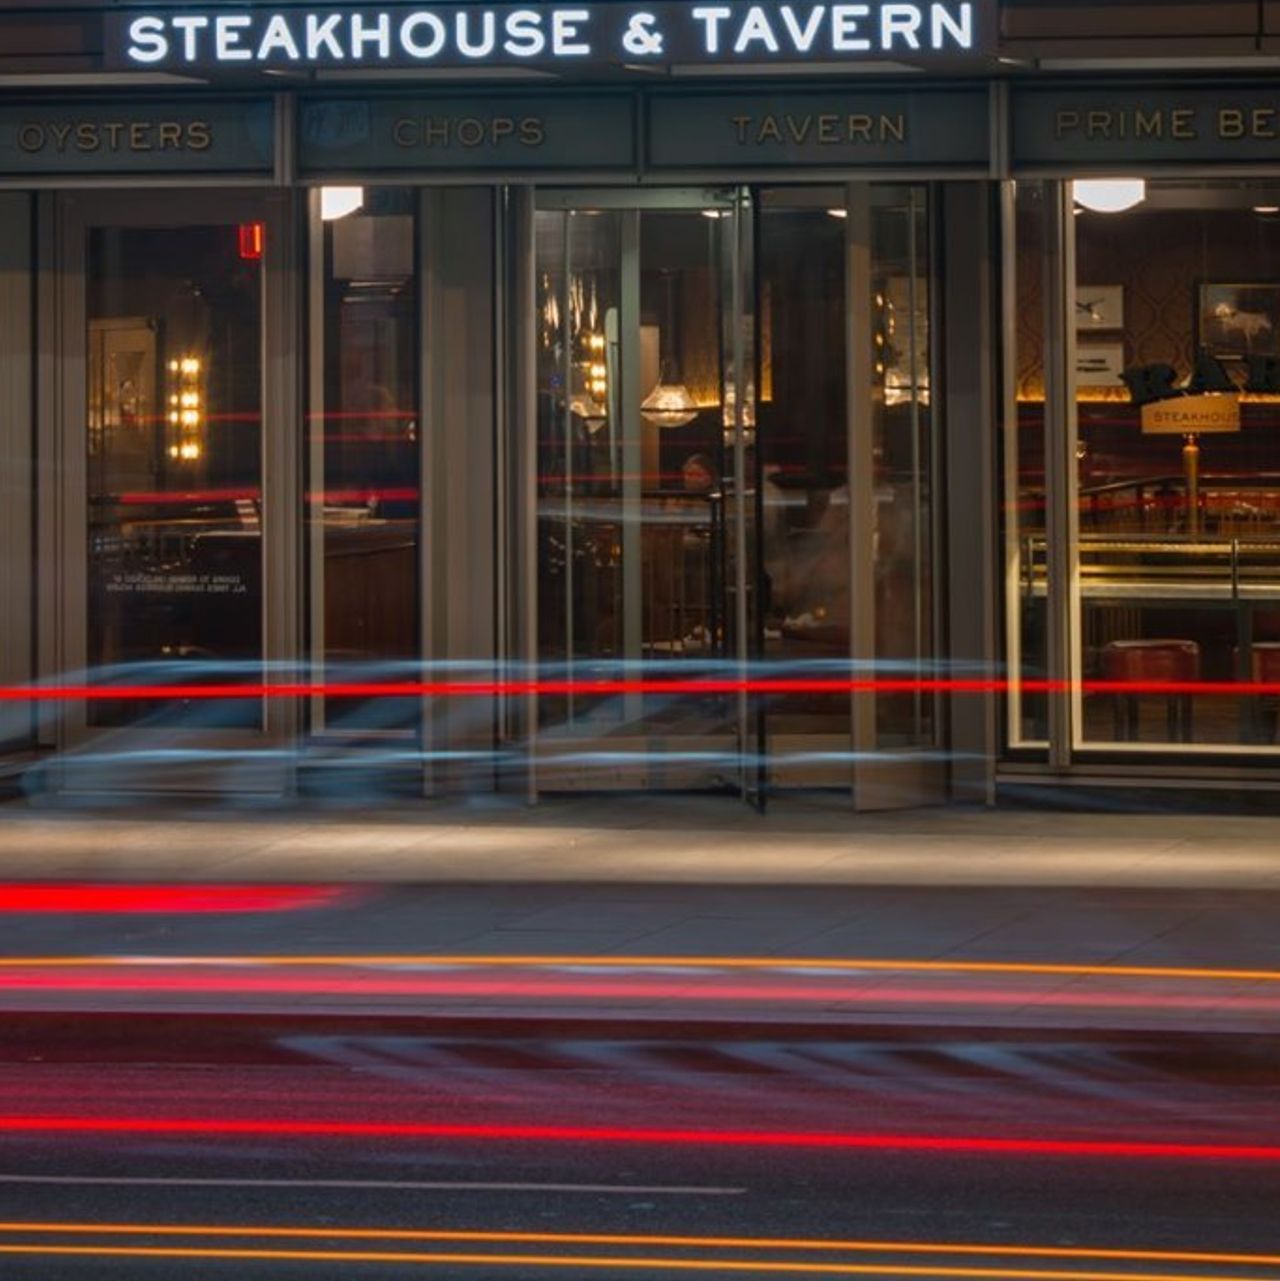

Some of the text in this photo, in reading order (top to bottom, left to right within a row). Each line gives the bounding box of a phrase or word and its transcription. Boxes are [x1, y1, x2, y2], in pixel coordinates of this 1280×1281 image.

[127, 2, 974, 63] STEAKHOUSE & TAVERN
[16, 120, 214, 152] OYSTERS
[391, 117, 548, 147] CHOPS
[731, 112, 907, 145] TAVERN
[1054, 108, 1196, 140] PRIME
